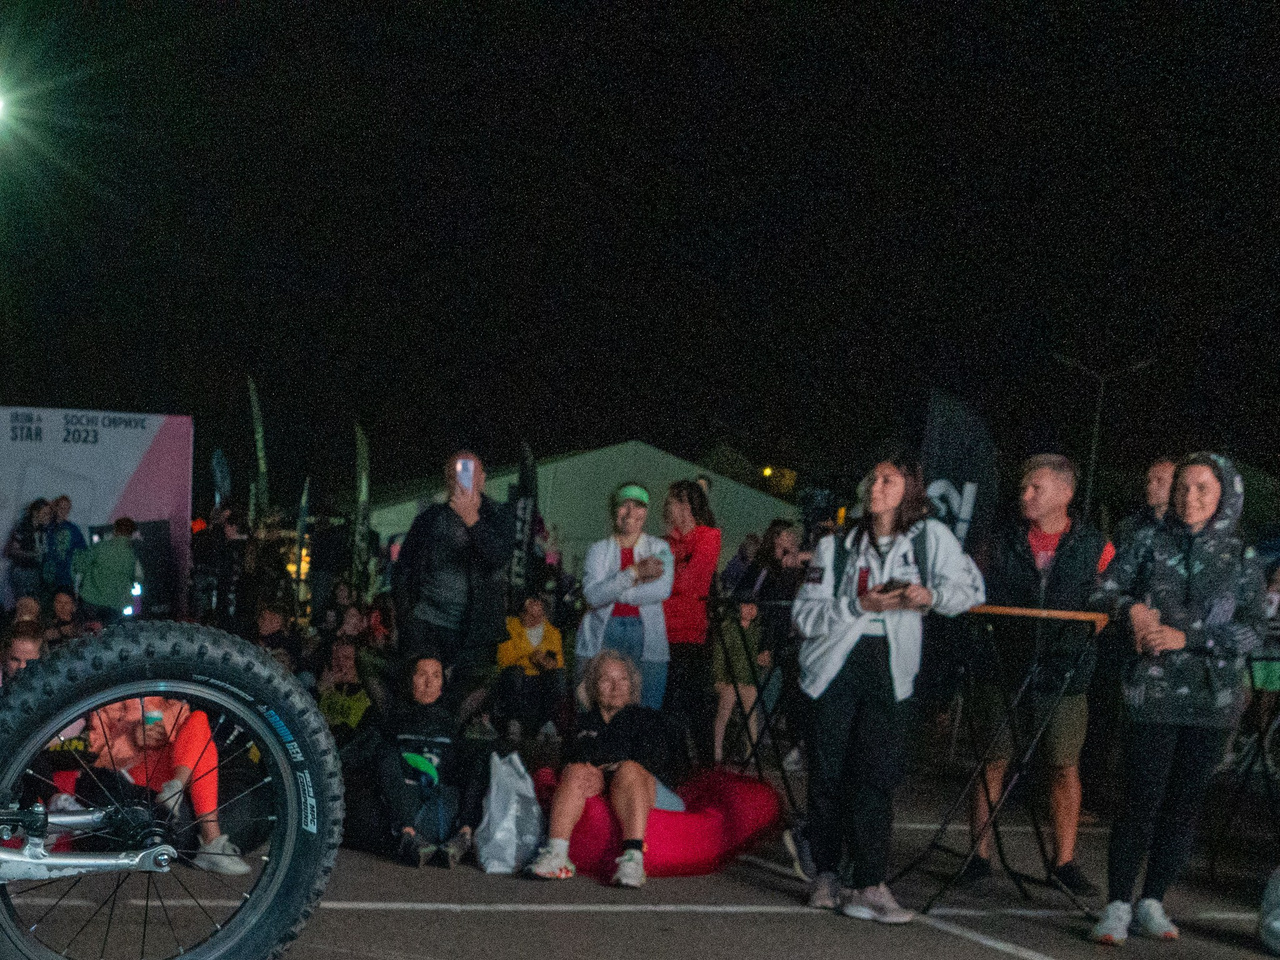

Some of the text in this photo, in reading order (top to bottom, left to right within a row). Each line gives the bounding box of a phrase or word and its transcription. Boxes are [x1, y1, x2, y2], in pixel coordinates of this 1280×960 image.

[63, 413, 99, 427] SOCHI
[10, 426, 43, 441] STAR
[63, 429, 99, 444] 2023
[265, 709, 305, 763] CROWN GEM
[299, 774, 309, 828] COMPOUND
